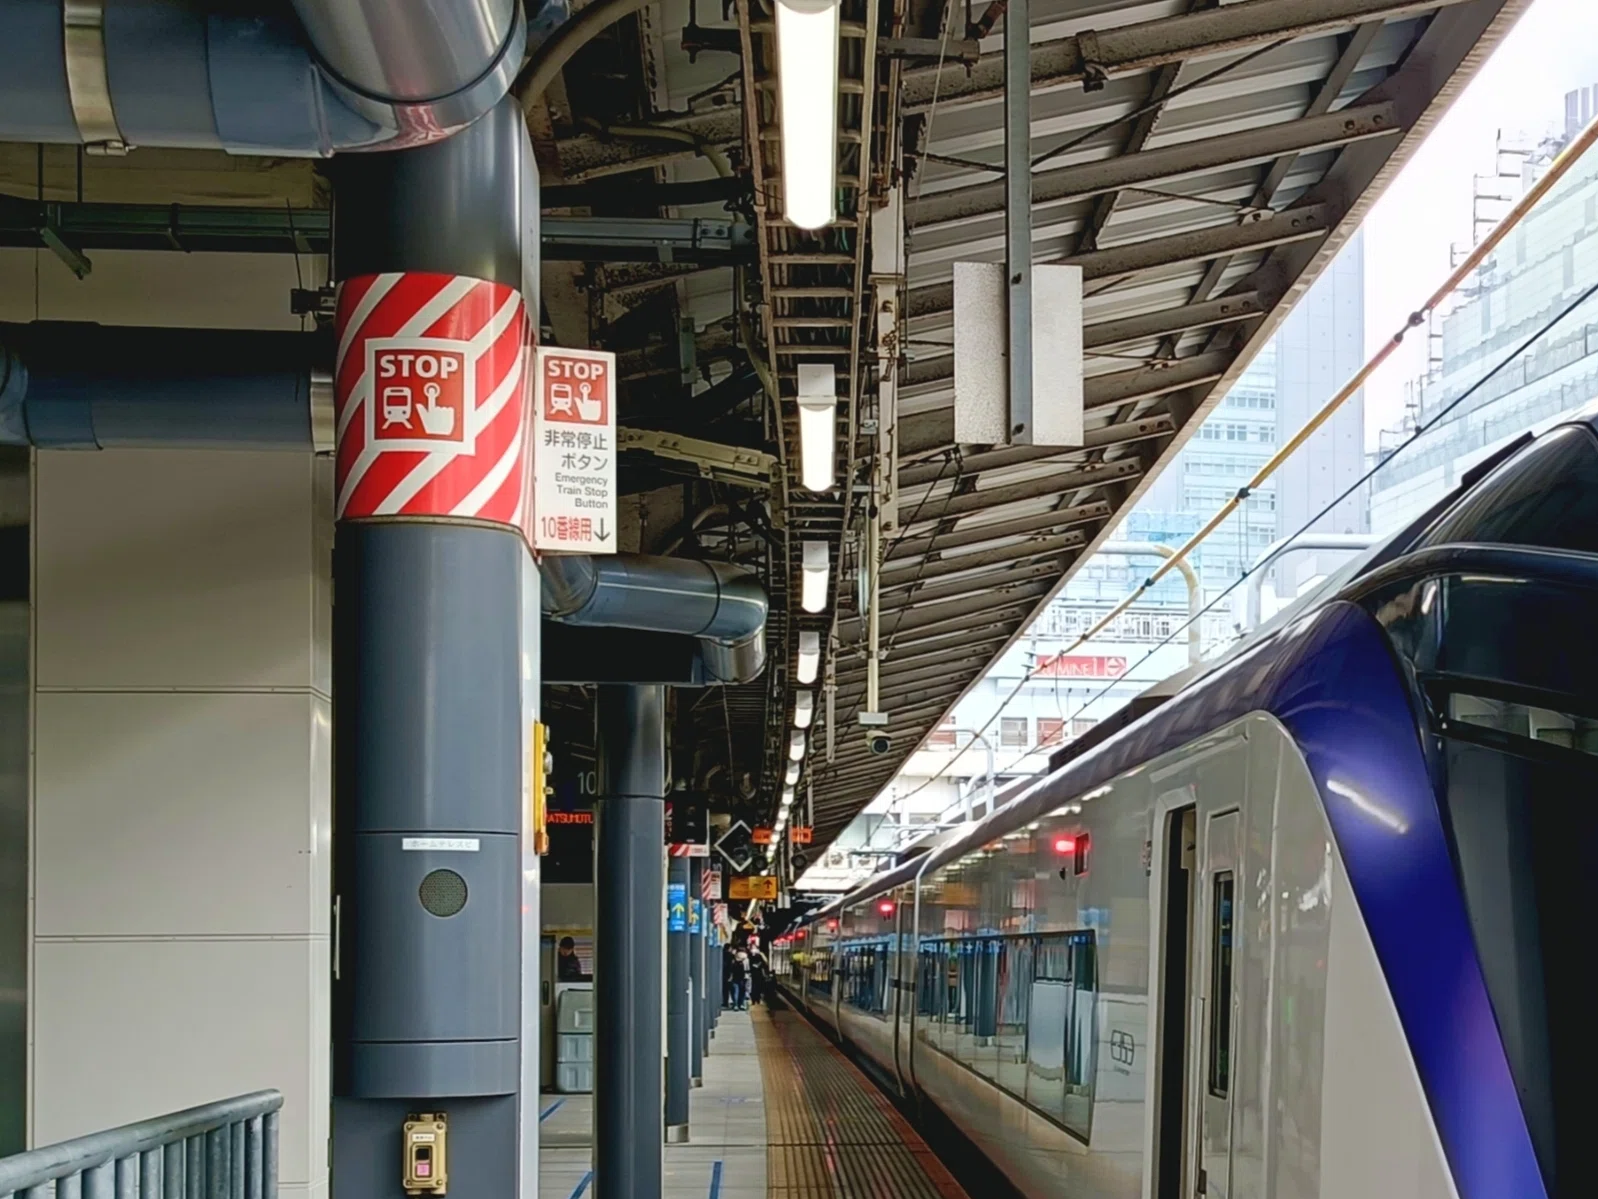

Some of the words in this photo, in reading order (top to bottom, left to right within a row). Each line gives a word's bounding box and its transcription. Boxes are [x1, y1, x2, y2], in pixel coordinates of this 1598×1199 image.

[380, 355, 458, 380] STOP
[548, 360, 604, 380] STOP
[544, 429, 608, 451] 非常停止
[561, 453, 608, 471] ボタン
[555, 472, 608, 487] Emergency
[557, 485, 582, 495] Train
[585, 487, 608, 498] Stop
[575, 498, 608, 508] Button
[541, 516, 592, 542] 10番線用
[577, 771, 597, 795] 10
